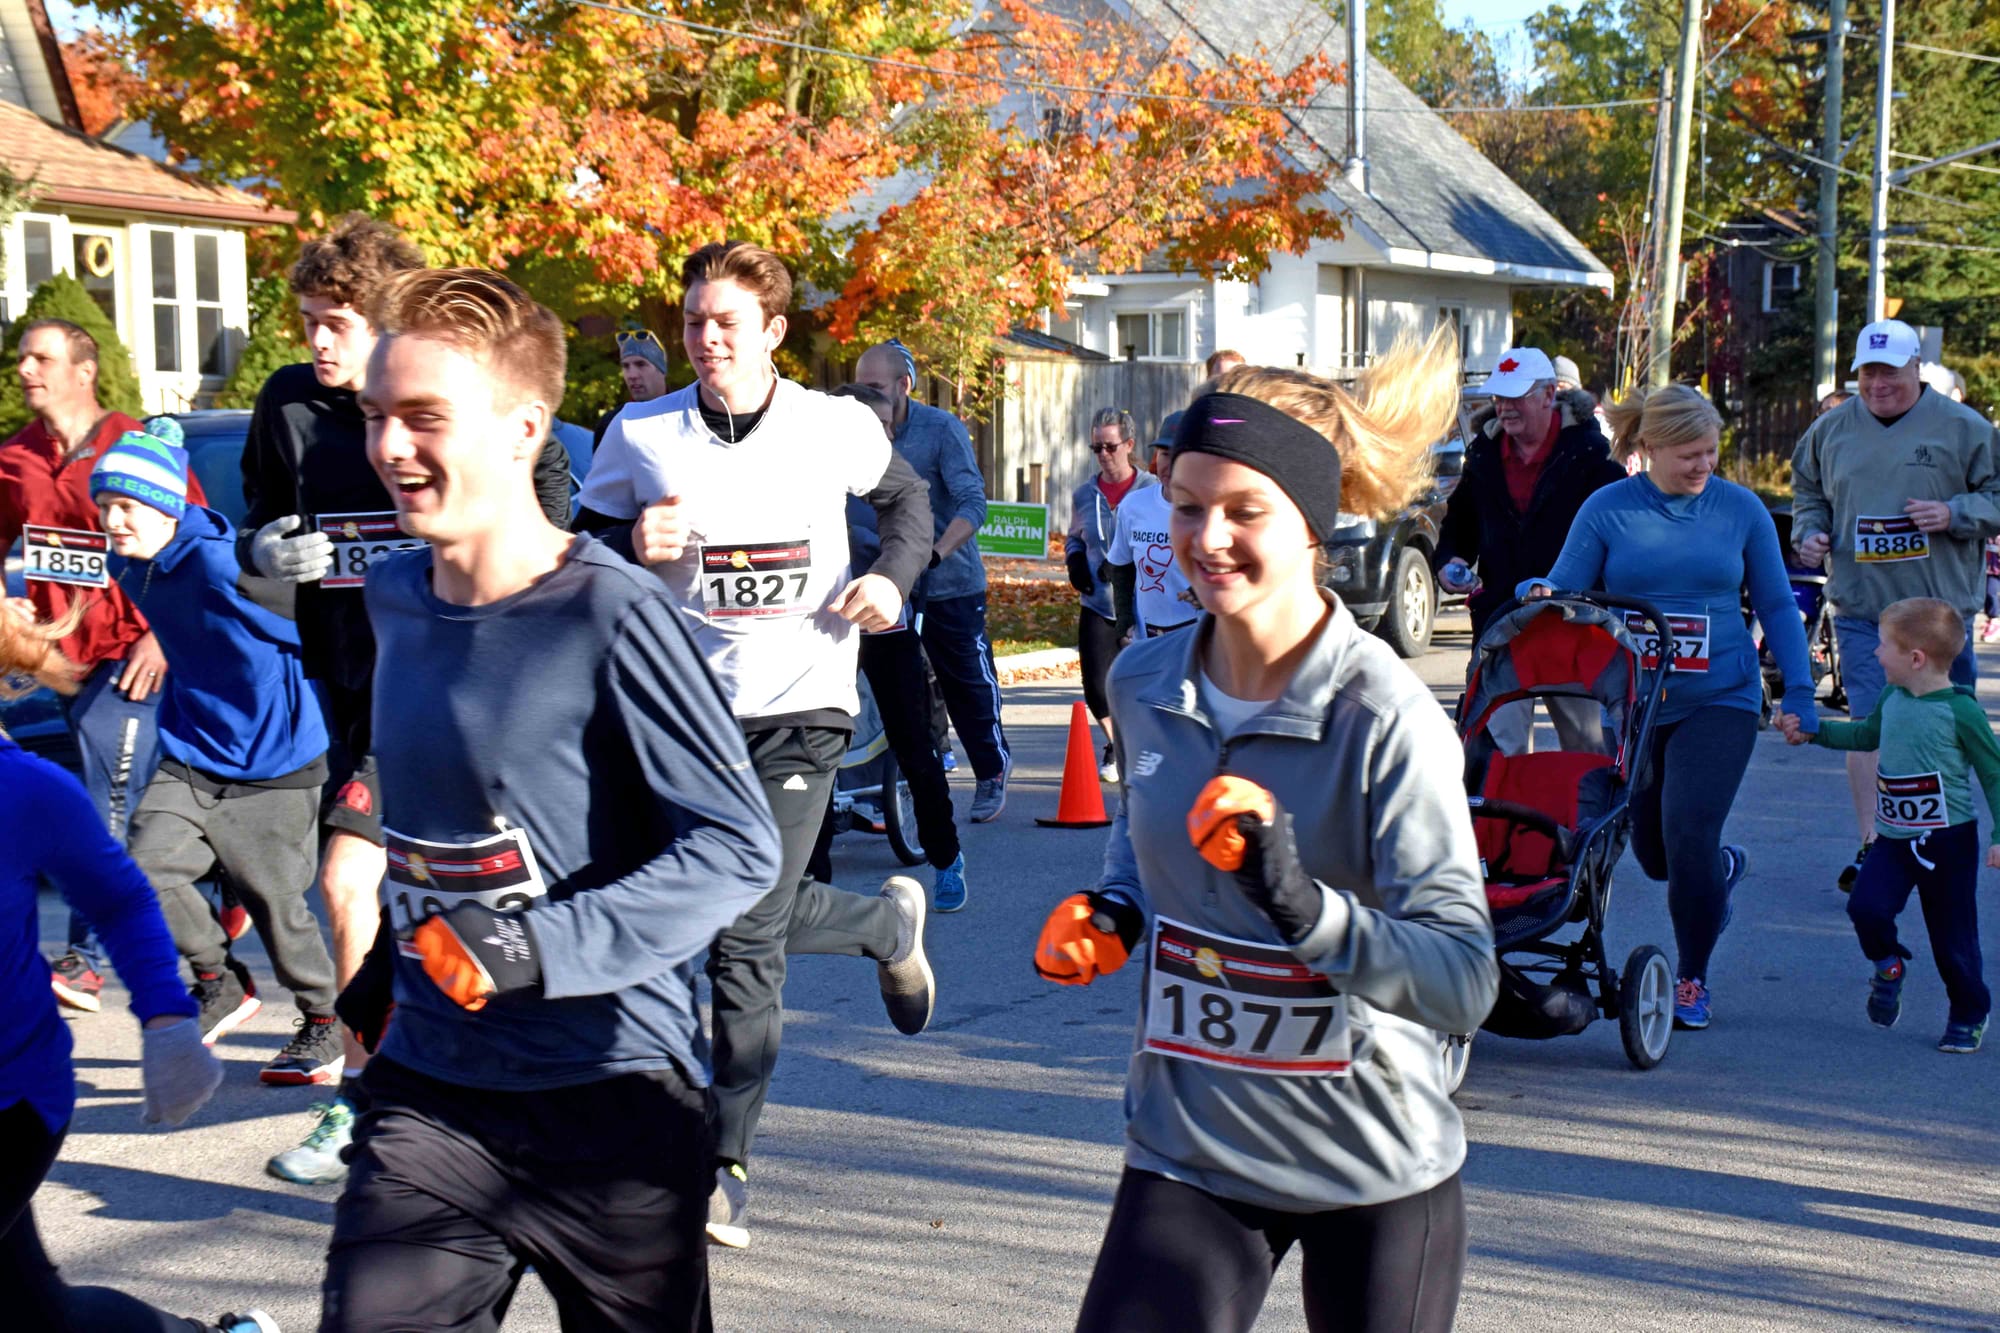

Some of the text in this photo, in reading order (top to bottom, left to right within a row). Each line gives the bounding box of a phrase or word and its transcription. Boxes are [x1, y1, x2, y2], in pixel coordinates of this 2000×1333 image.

[105, 476, 186, 511] RESORT
[979, 524, 1043, 540] MARTIN
[994, 515, 1028, 525] RALPH
[1860, 533, 1925, 555] 1886
[31, 550, 103, 577] 1859
[710, 573, 808, 607] 1827
[1163, 984, 1334, 1056] 1877
